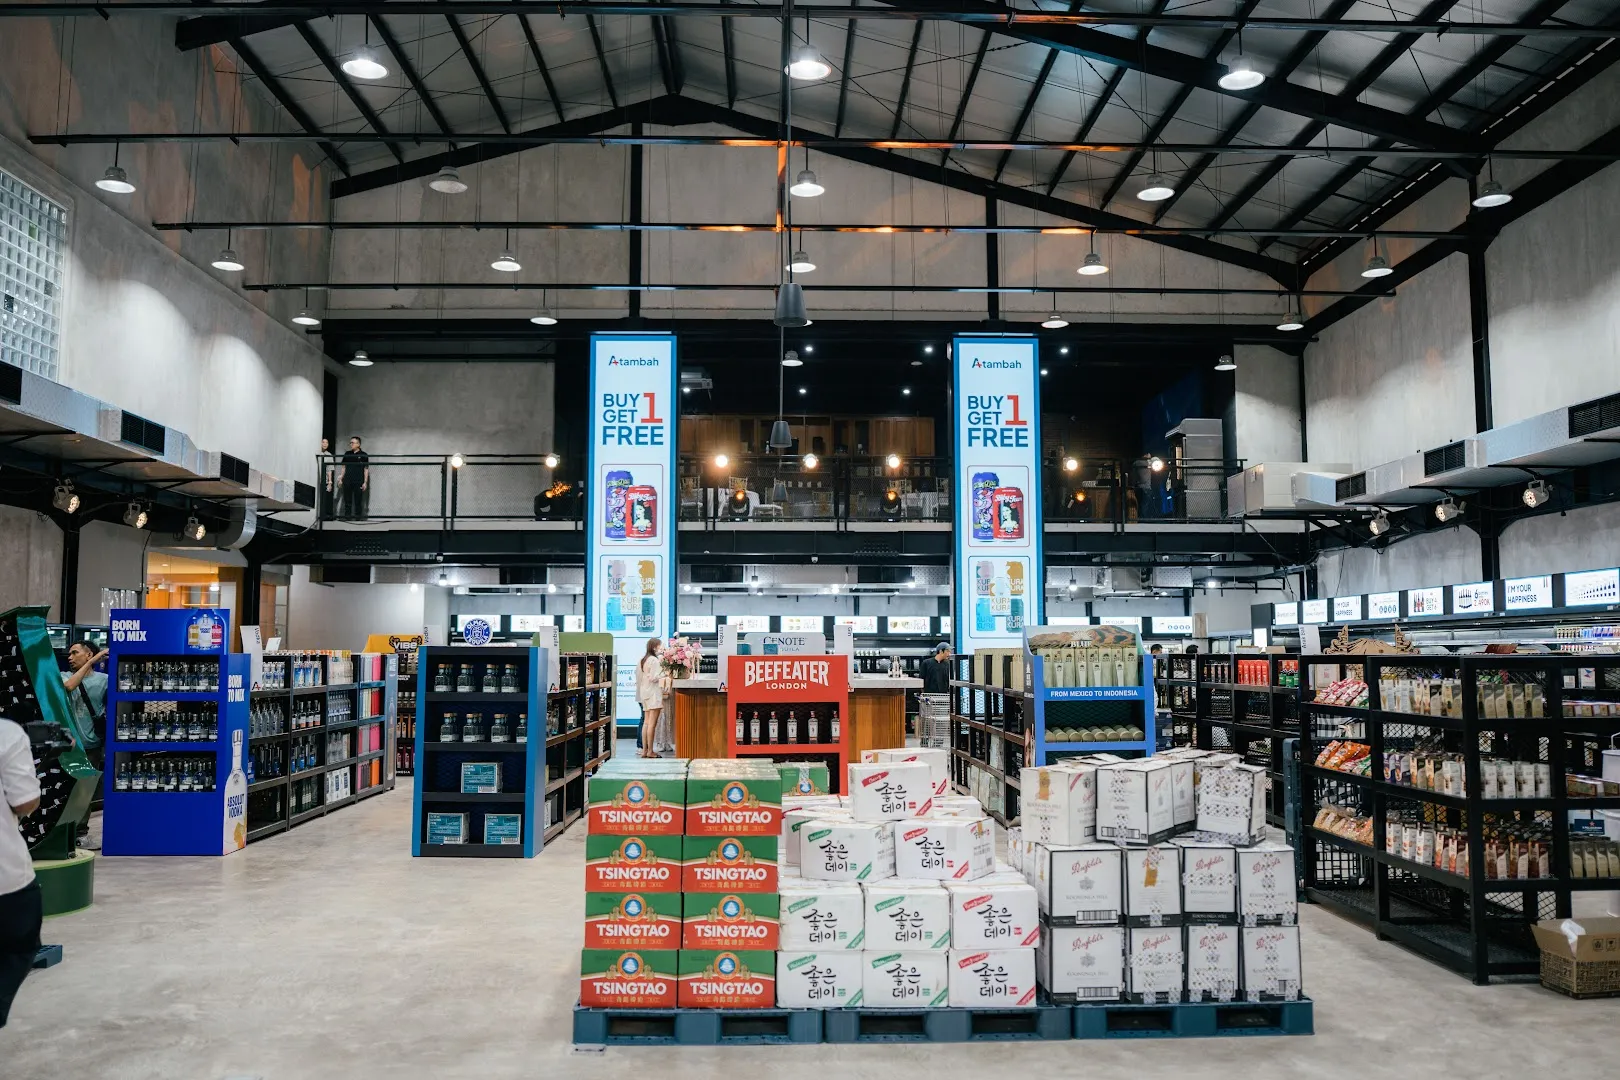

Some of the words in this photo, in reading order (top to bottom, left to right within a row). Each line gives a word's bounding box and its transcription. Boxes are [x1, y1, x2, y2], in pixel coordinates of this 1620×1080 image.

[603, 393, 640, 407] BUY
[640, 392, 663, 423] 1
[968, 395, 1004, 409] BUY
[1005, 395, 1027, 425] 1
[602, 409, 637, 423] GET
[968, 411, 1002, 425] GET
[602, 426, 664, 445] FREE
[968, 428, 1028, 447] FREE
[1516, 584, 1532, 592] YOUR
[1508, 594, 1537, 604] HAPPINESS
[112, 620, 140, 630] BORN
[466, 619, 488, 629] OLMECA
[112, 631, 125, 641] TO
[126, 631, 147, 641] MIX
[466, 635, 488, 646] TEQUILA
[763, 636, 805, 645] CENOTE
[745, 661, 829, 686] BEEFEATER
[228, 675, 243, 688] BORN
[228, 689, 234, 702] TO
[235, 689, 245, 702] MIX
[875, 782, 907, 802] 좋은
[228, 794, 244, 807] ABSOLUT
[881, 801, 906, 813] 데이
[229, 805, 243, 818] VODKA
[599, 810, 672, 823] TSINGTAO
[699, 811, 772, 824] TSINGTAO
[819, 840, 849, 860] 좋은
[915, 837, 945, 857] 좋은
[825, 861, 848, 872] 데이
[921, 858, 944, 869] 데이
[596, 867, 670, 880] TSINGTAO
[694, 867, 767, 880] TSINGTAO
[802, 909, 838, 931] 좋은
[889, 908, 924, 930] 좋은
[977, 904, 1012, 927] 좋은
[596, 924, 670, 937] TSINGTAO
[694, 925, 768, 938] TSINGTAO
[809, 930, 836, 943] 데이
[895, 929, 922, 942] 데이
[984, 925, 1011, 938] 데이
[801, 965, 837, 987] 좋은
[886, 964, 921, 986] 좋은
[973, 962, 1008, 985] 좋은
[593, 982, 667, 995] TSINGTAO
[690, 982, 763, 995] TSINGTAO
[808, 986, 835, 999] 데이
[892, 985, 920, 998] 데이
[980, 984, 1007, 998] 데이
